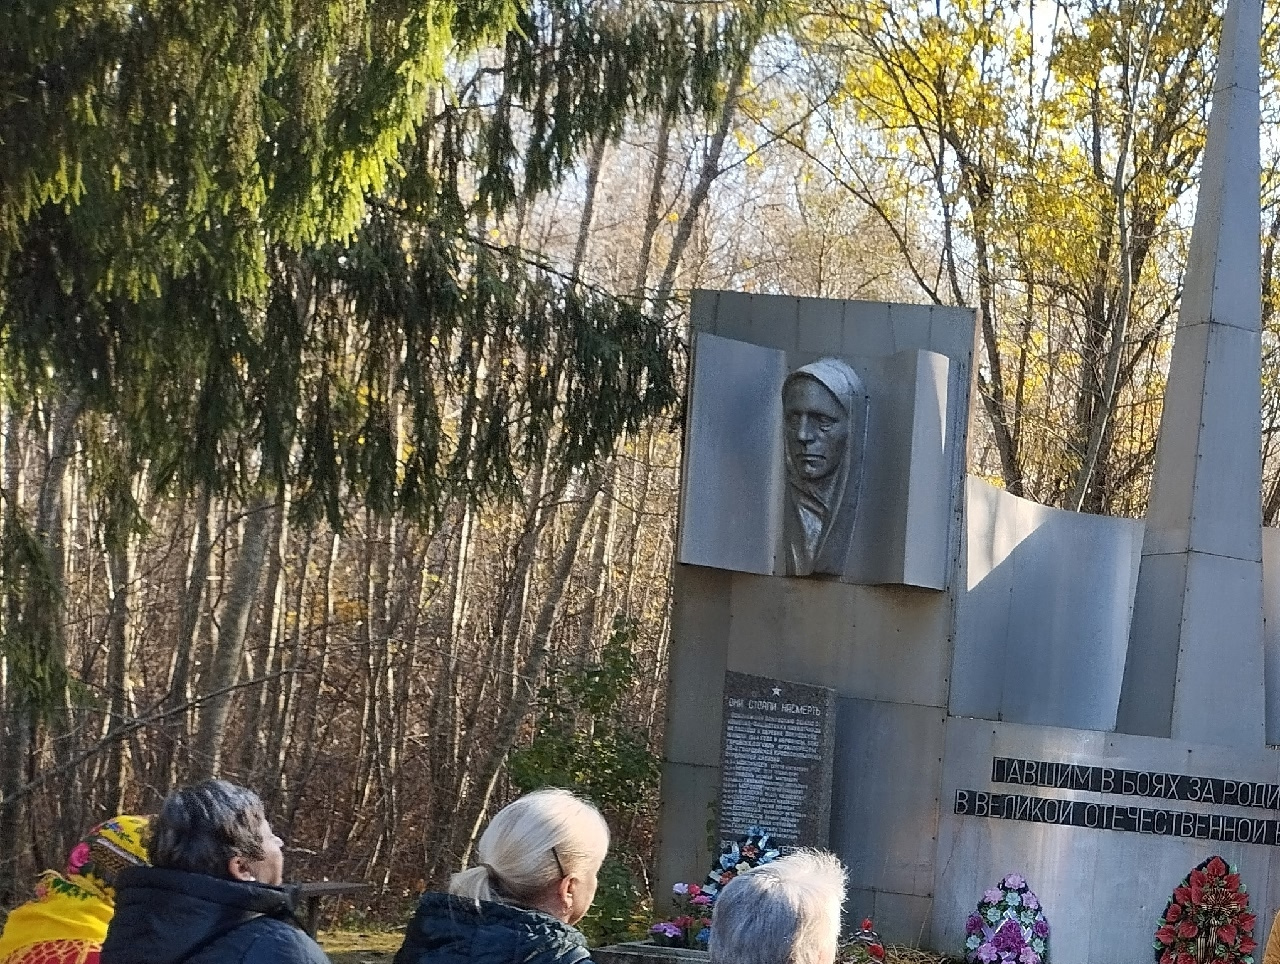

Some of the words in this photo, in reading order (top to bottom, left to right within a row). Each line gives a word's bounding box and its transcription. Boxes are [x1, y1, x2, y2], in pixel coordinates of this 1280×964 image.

[993, 757, 1093, 791] ПАВШИМ
[1101, 767, 1115, 793] В
[1122, 770, 1181, 801] БОЯХ
[1186, 777, 1216, 804] ЗА
[954, 789, 969, 815] В
